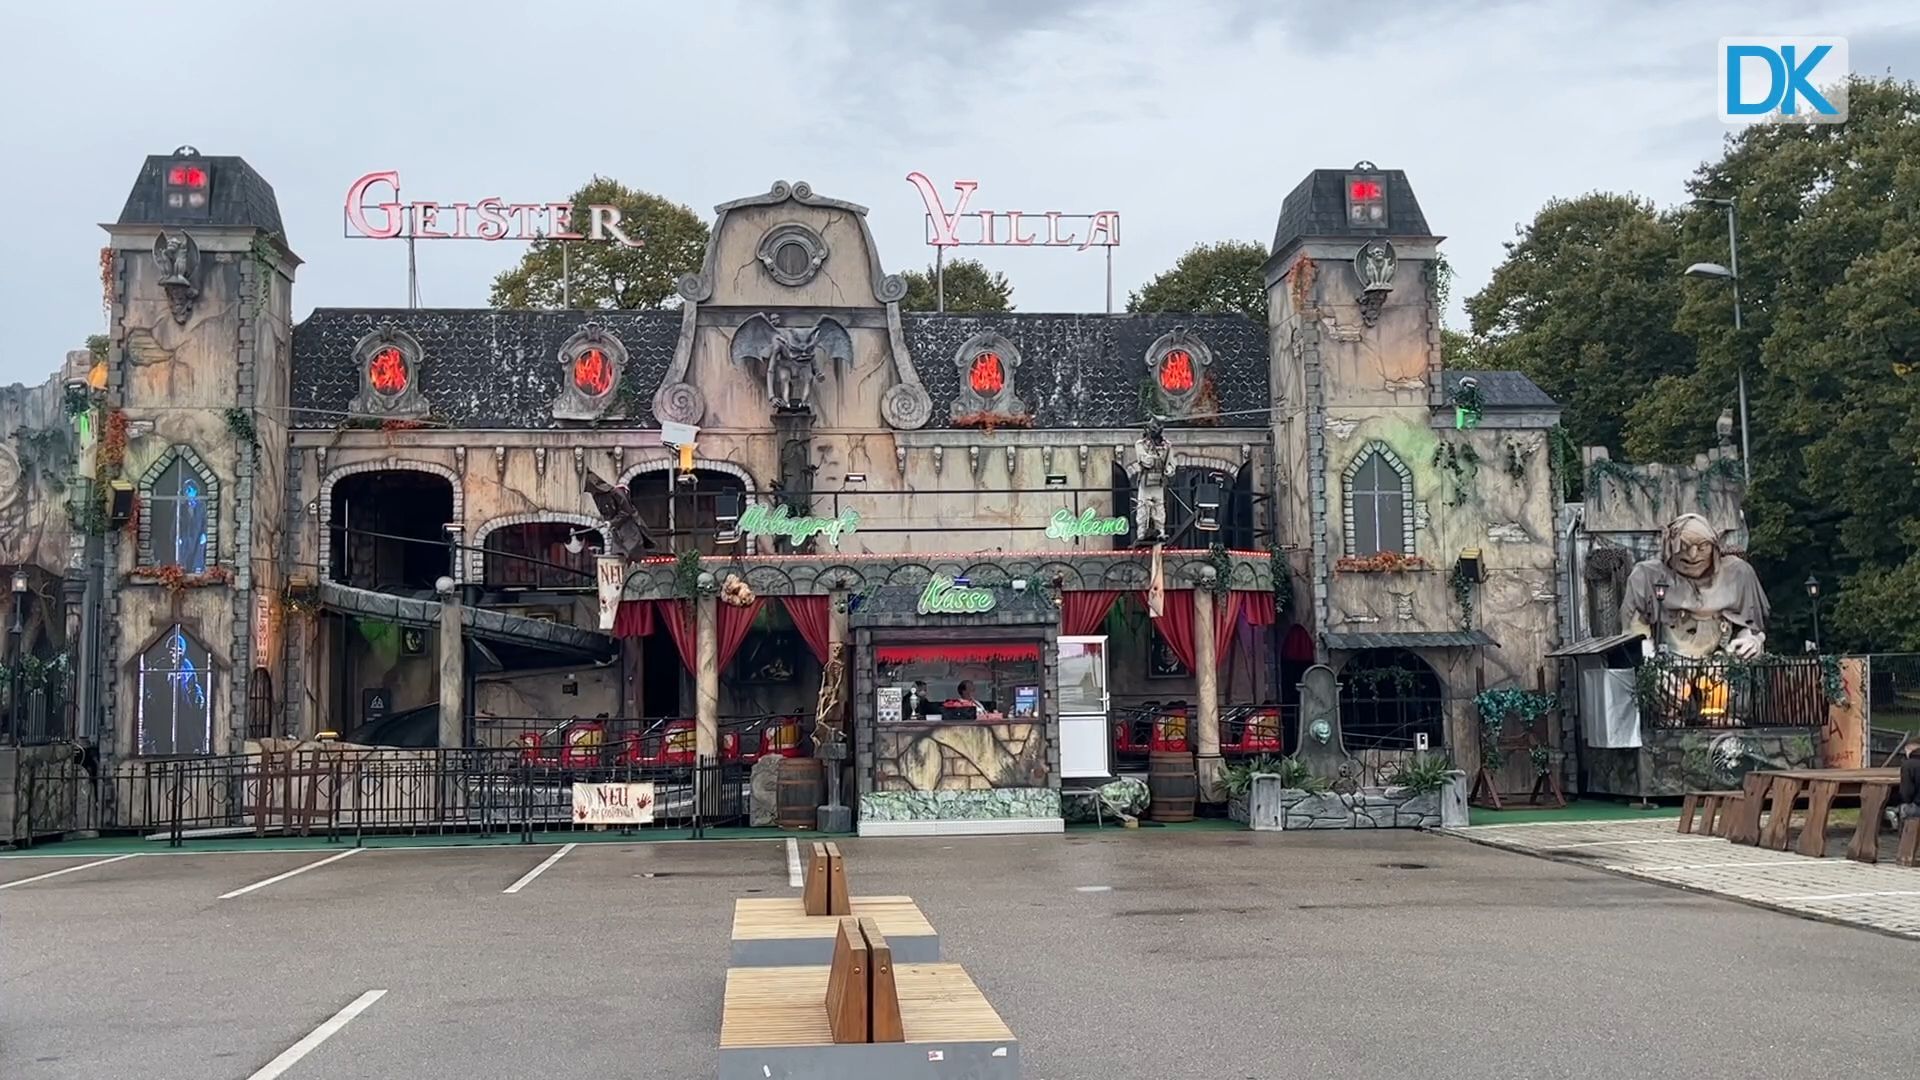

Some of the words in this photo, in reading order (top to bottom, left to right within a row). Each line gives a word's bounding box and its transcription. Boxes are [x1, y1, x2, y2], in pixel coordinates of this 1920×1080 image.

[345, 170, 644, 248] GEISTER
[906, 171, 1120, 251] VILLA
[918, 572, 996, 615] Kasse
[596, 785, 629, 807] NEU
